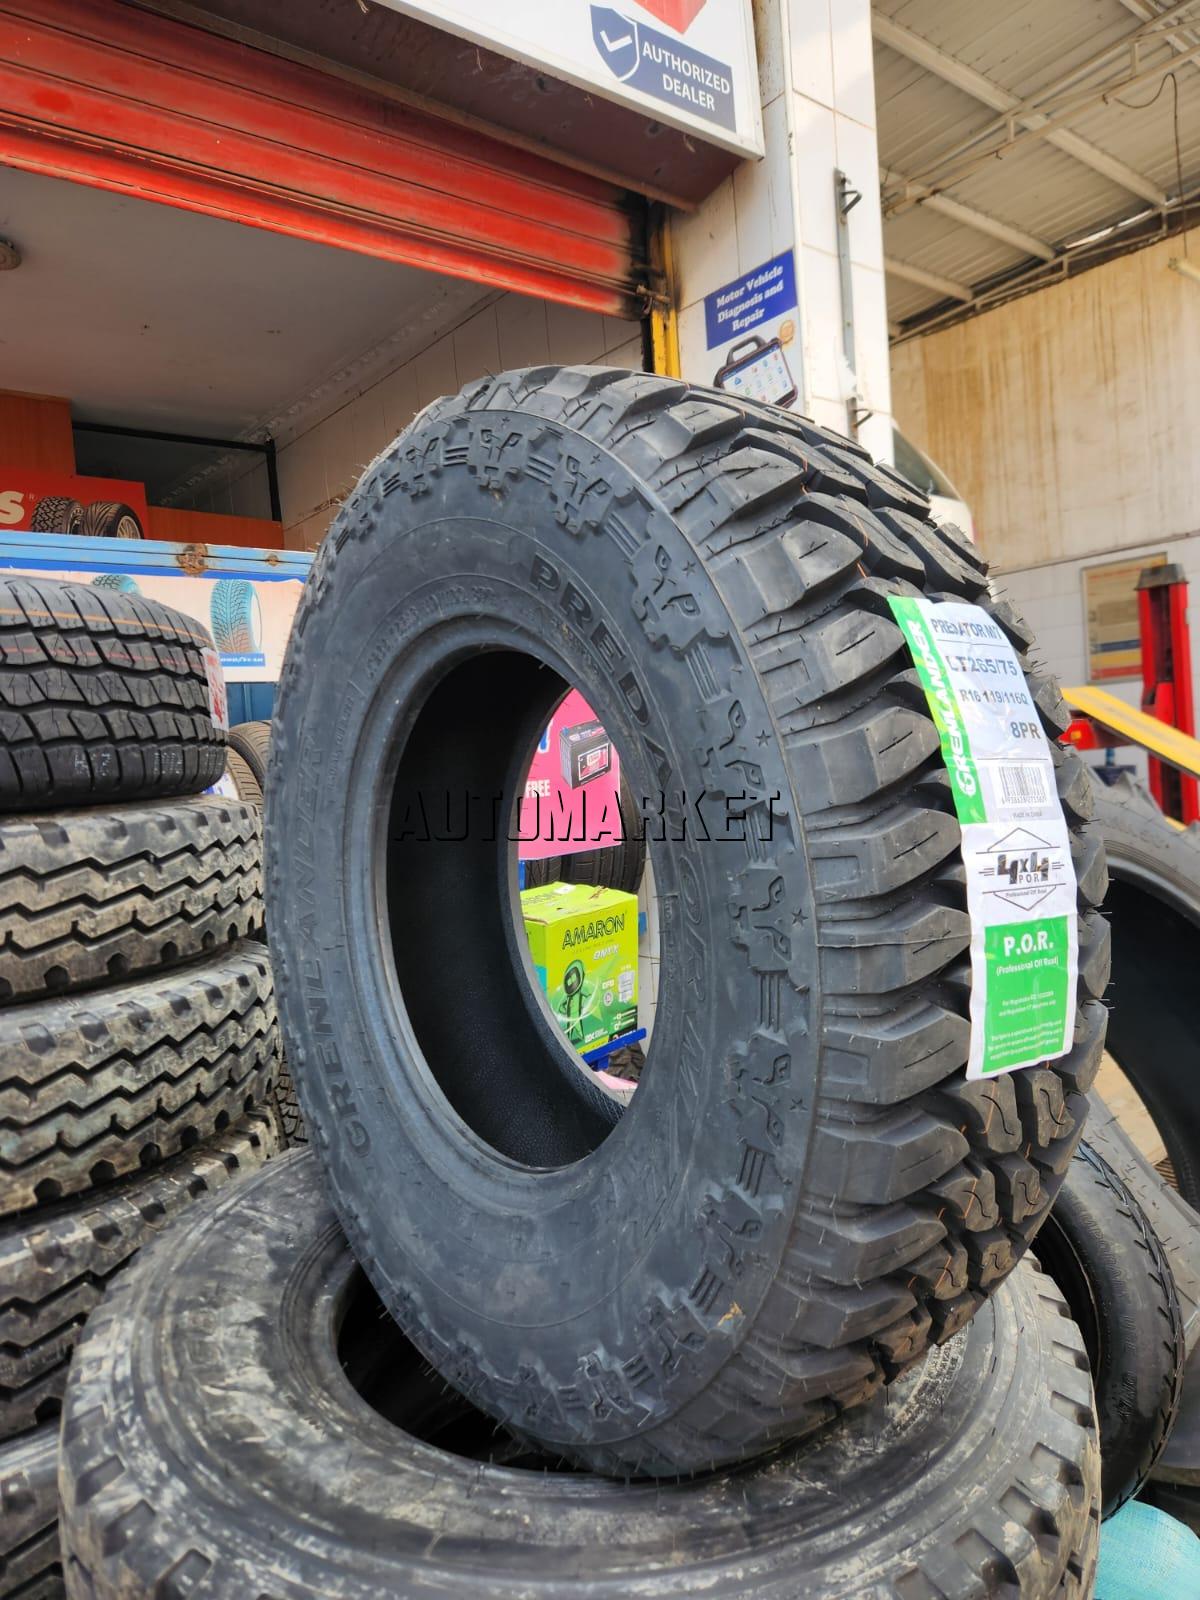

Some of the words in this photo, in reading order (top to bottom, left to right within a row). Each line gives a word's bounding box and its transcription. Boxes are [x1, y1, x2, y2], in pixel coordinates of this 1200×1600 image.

[643, 41, 730, 94] AUTHORIZED
[662, 74, 715, 111] DEALER
[716, 287, 746, 309] Motor
[745, 265, 783, 291] Vehicle
[717, 292, 763, 323] Diagnosis
[764, 279, 784, 299] and
[732, 308, 765, 331] Repair
[930, 618, 988, 637] PREDATOR
[959, 688, 981, 703] R16
[982, 689, 1030, 705] 119/116Q
[1010, 721, 1041, 740] 8PR
[525, 779, 551, 798] FREE
[562, 913, 625, 950] AMARON
[1003, 930, 1055, 957] P.O.R.
[996, 961, 1034, 976] (Professional
